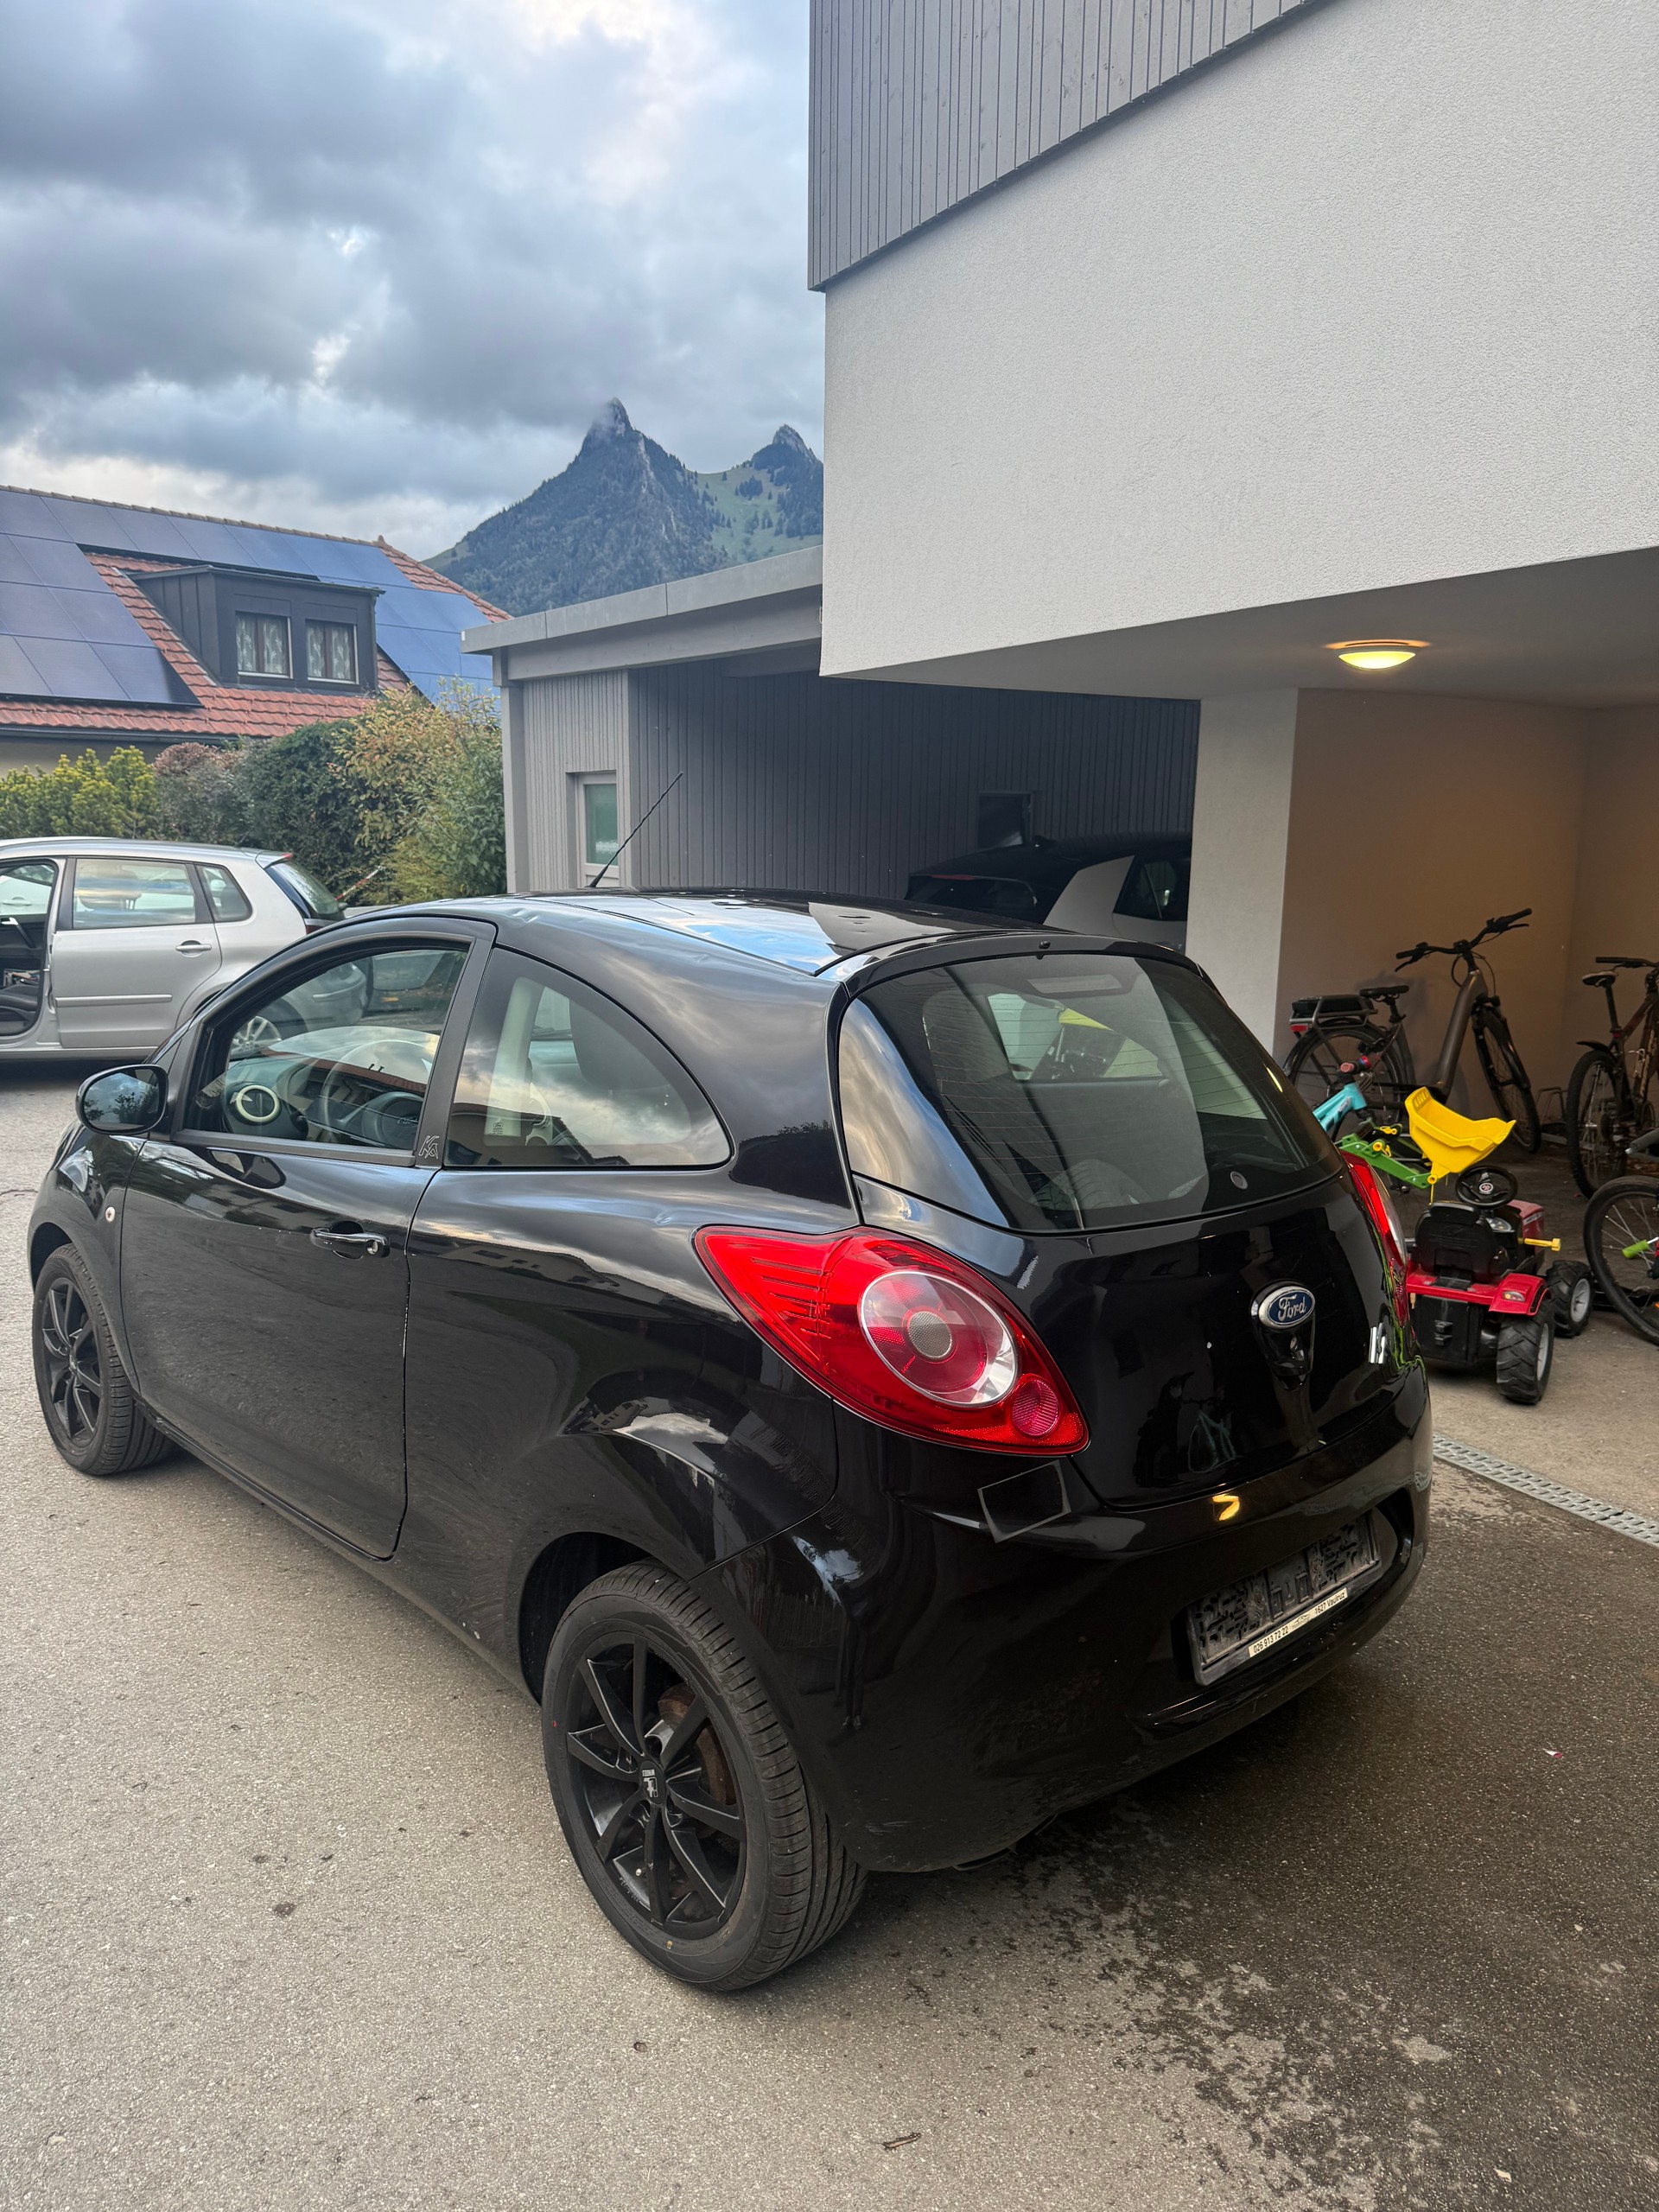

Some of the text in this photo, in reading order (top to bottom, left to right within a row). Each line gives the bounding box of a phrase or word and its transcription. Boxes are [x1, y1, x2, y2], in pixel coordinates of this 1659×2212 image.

[1277, 1294, 1307, 1321] Ford
[1253, 1641, 1264, 1654] 026
[1263, 1635, 1274, 1648] 913
[1274, 1630, 1281, 1640] 72
[1281, 1625, 1289, 1636] 22
[1314, 1602, 1326, 1615] 1627
